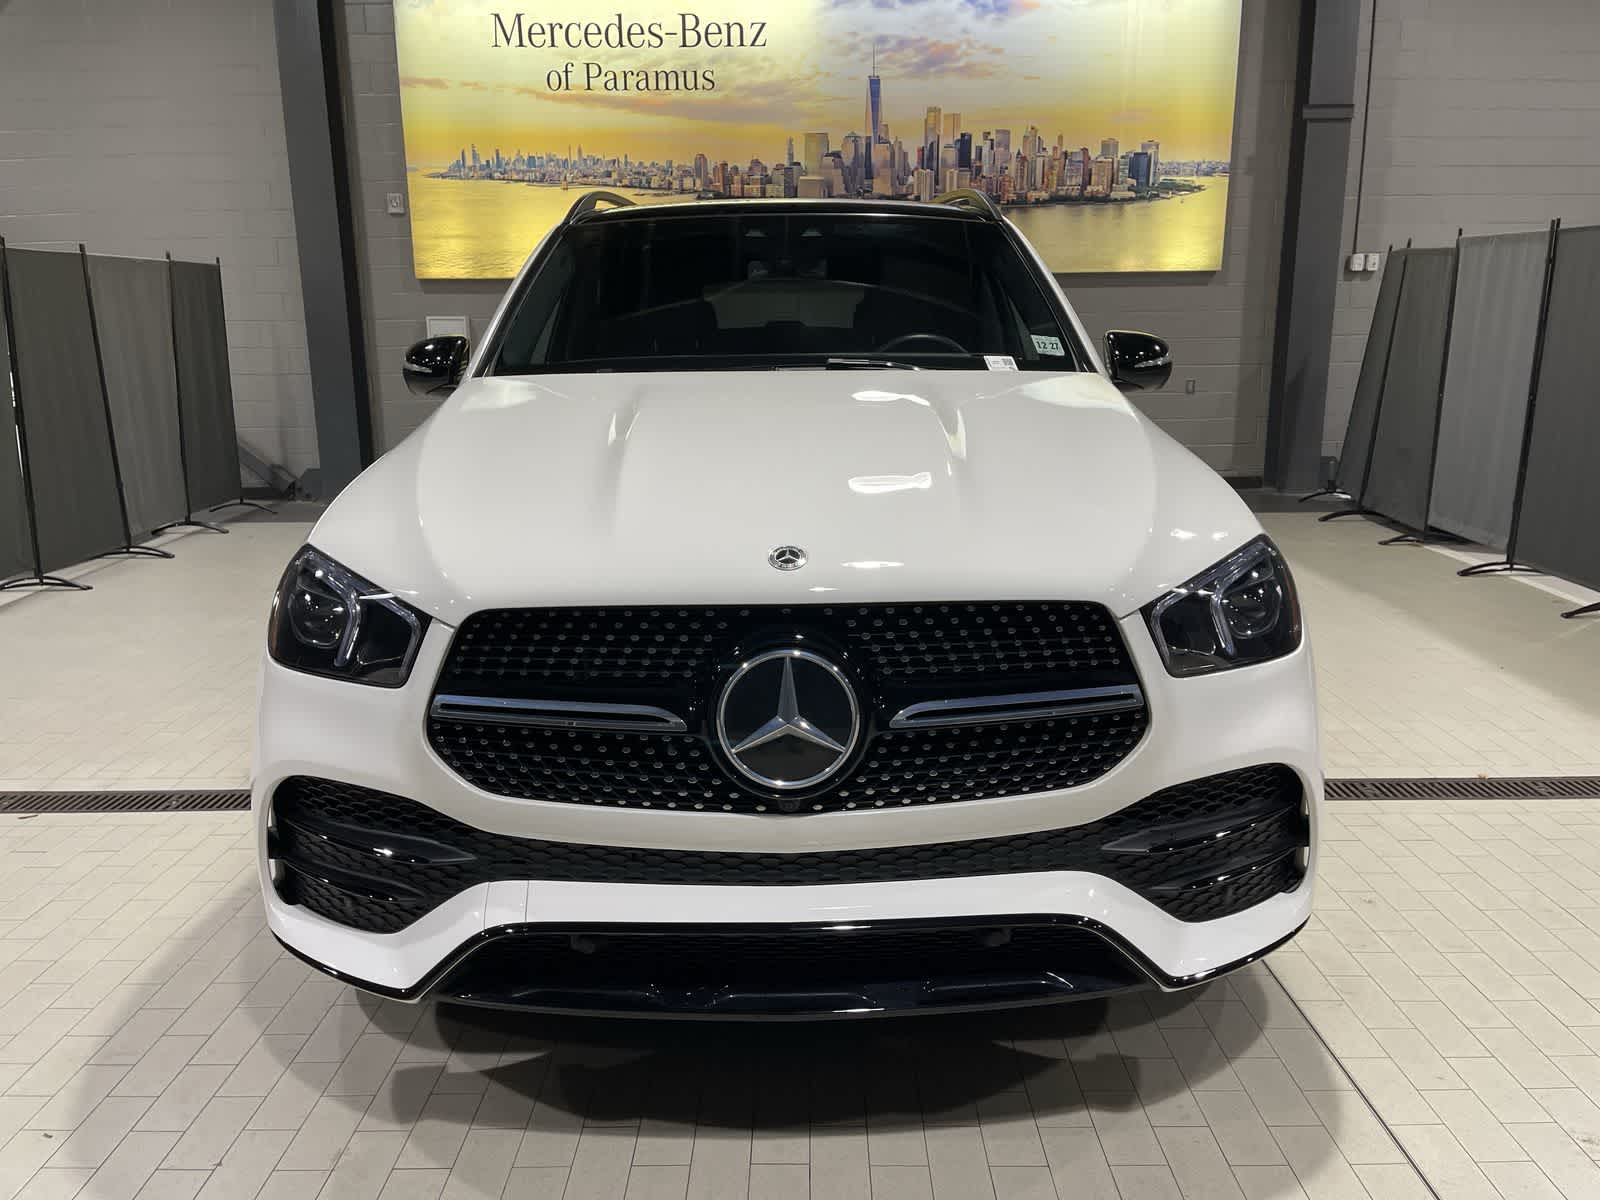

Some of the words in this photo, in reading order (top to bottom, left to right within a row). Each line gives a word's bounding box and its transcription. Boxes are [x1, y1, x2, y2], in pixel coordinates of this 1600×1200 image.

[490, 12, 768, 49] Mercedes-Benz
[545, 62, 574, 92] of
[583, 62, 716, 92] Paramus
[1036, 341, 1048, 350] 12
